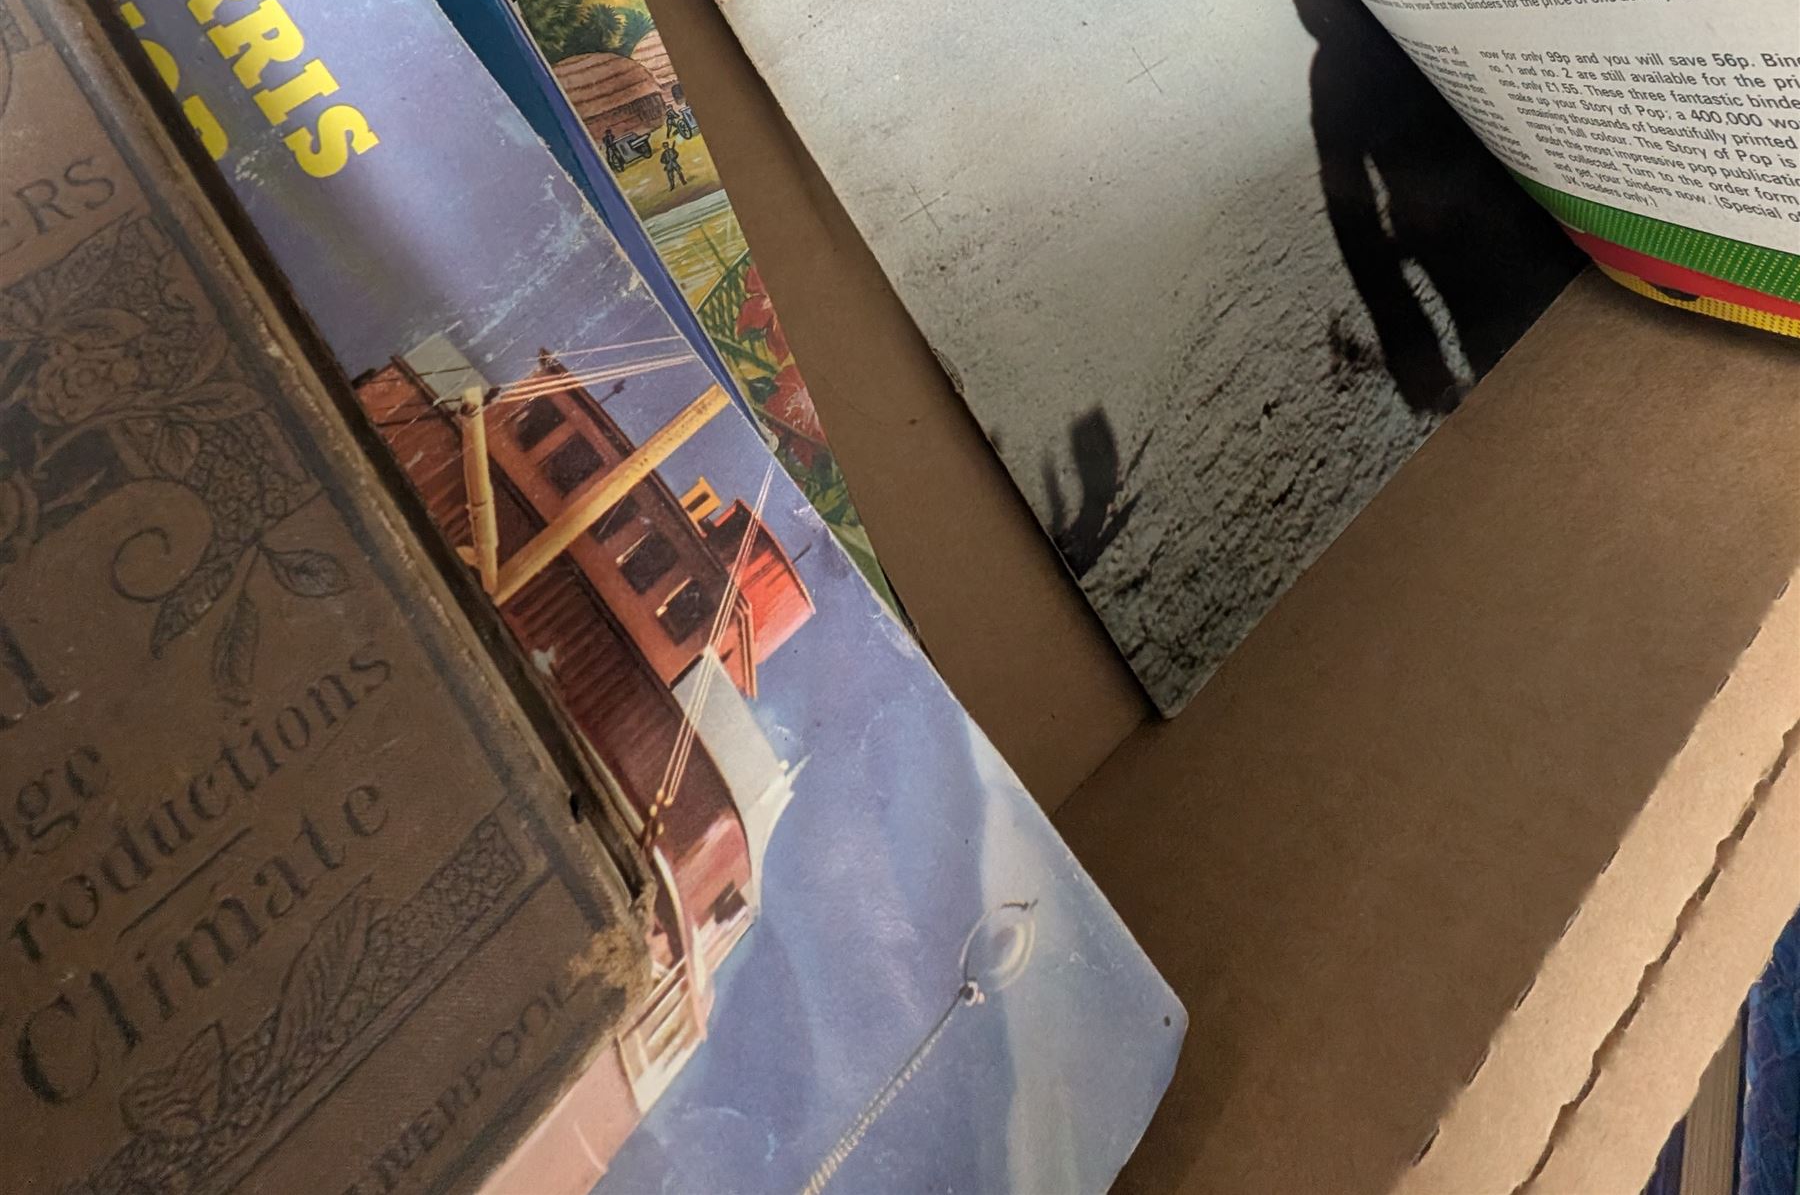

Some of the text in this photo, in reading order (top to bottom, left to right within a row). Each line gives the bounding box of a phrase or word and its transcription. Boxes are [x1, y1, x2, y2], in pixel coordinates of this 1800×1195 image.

[1480, 50, 1499, 60] now
[1501, 50, 1516, 60] for
[1521, 52, 1544, 64] only
[1546, 51, 1571, 65] 99p
[1577, 53, 1599, 64] and
[1603, 55, 1630, 67] you
[1635, 53, 1663, 65] will
[1669, 56, 1707, 67] save
[1712, 54, 1755, 70] 56p.
[1506, 64, 1513, 74] 1
[1518, 66, 1537, 76] and
[1541, 68, 1558, 78] no.
[1562, 67, 1572, 79] 2
[1577, 70, 1597, 80] are
[1601, 70, 1626, 82] still
[1630, 71, 1697, 85] available
[1701, 73, 1726, 86] for
[1733, 74, 1766, 88] the
[1521, 81, 1543, 92] only
[1584, 84, 1624, 99] These
[1628, 88, 1666, 102] three
[1670, 90, 1743, 106] fantastic
[1536, 97, 1549, 107] up
[1553, 100, 1576, 109] your
[1580, 100, 1613, 116] Story
[1619, 104, 1632, 115] of
[1676, 111, 1686, 121] a
[1768, 118, 1800, 130] wo
[1517, 107, 1568, 124] containing
[1568, 113, 1630, 131] thousands
[1632, 121, 1648, 132] of
[1647, 122, 1727, 145] beautifully
[1732, 132, 1798, 149] printed
[1567, 126, 1587, 138] full
[1591, 131, 1632, 145] colour.
[1633, 136, 1663, 150] The
[1666, 140, 1707, 159] Story
[1714, 148, 1730, 160] of
[1735, 149, 1772, 167] Pop
[1778, 154, 1797, 169] is
[1584, 143, 1615, 156] most
[1613, 148, 1685, 170] impressive
[1688, 162, 1717, 177] pop
[1622, 163, 1655, 179] Turn
[1658, 171, 1674, 183] to
[1678, 174, 1703, 188] the
[1709, 181, 1750, 197] order
[1755, 187, 1800, 205] form
[1625, 178, 1672, 196] binders
[1676, 190, 1712, 205] now.
[1714, 195, 1782, 219] (Special
[16, 785, 390, 1105] Climate
[345, 978, 590, 1195] IVERPOOL
